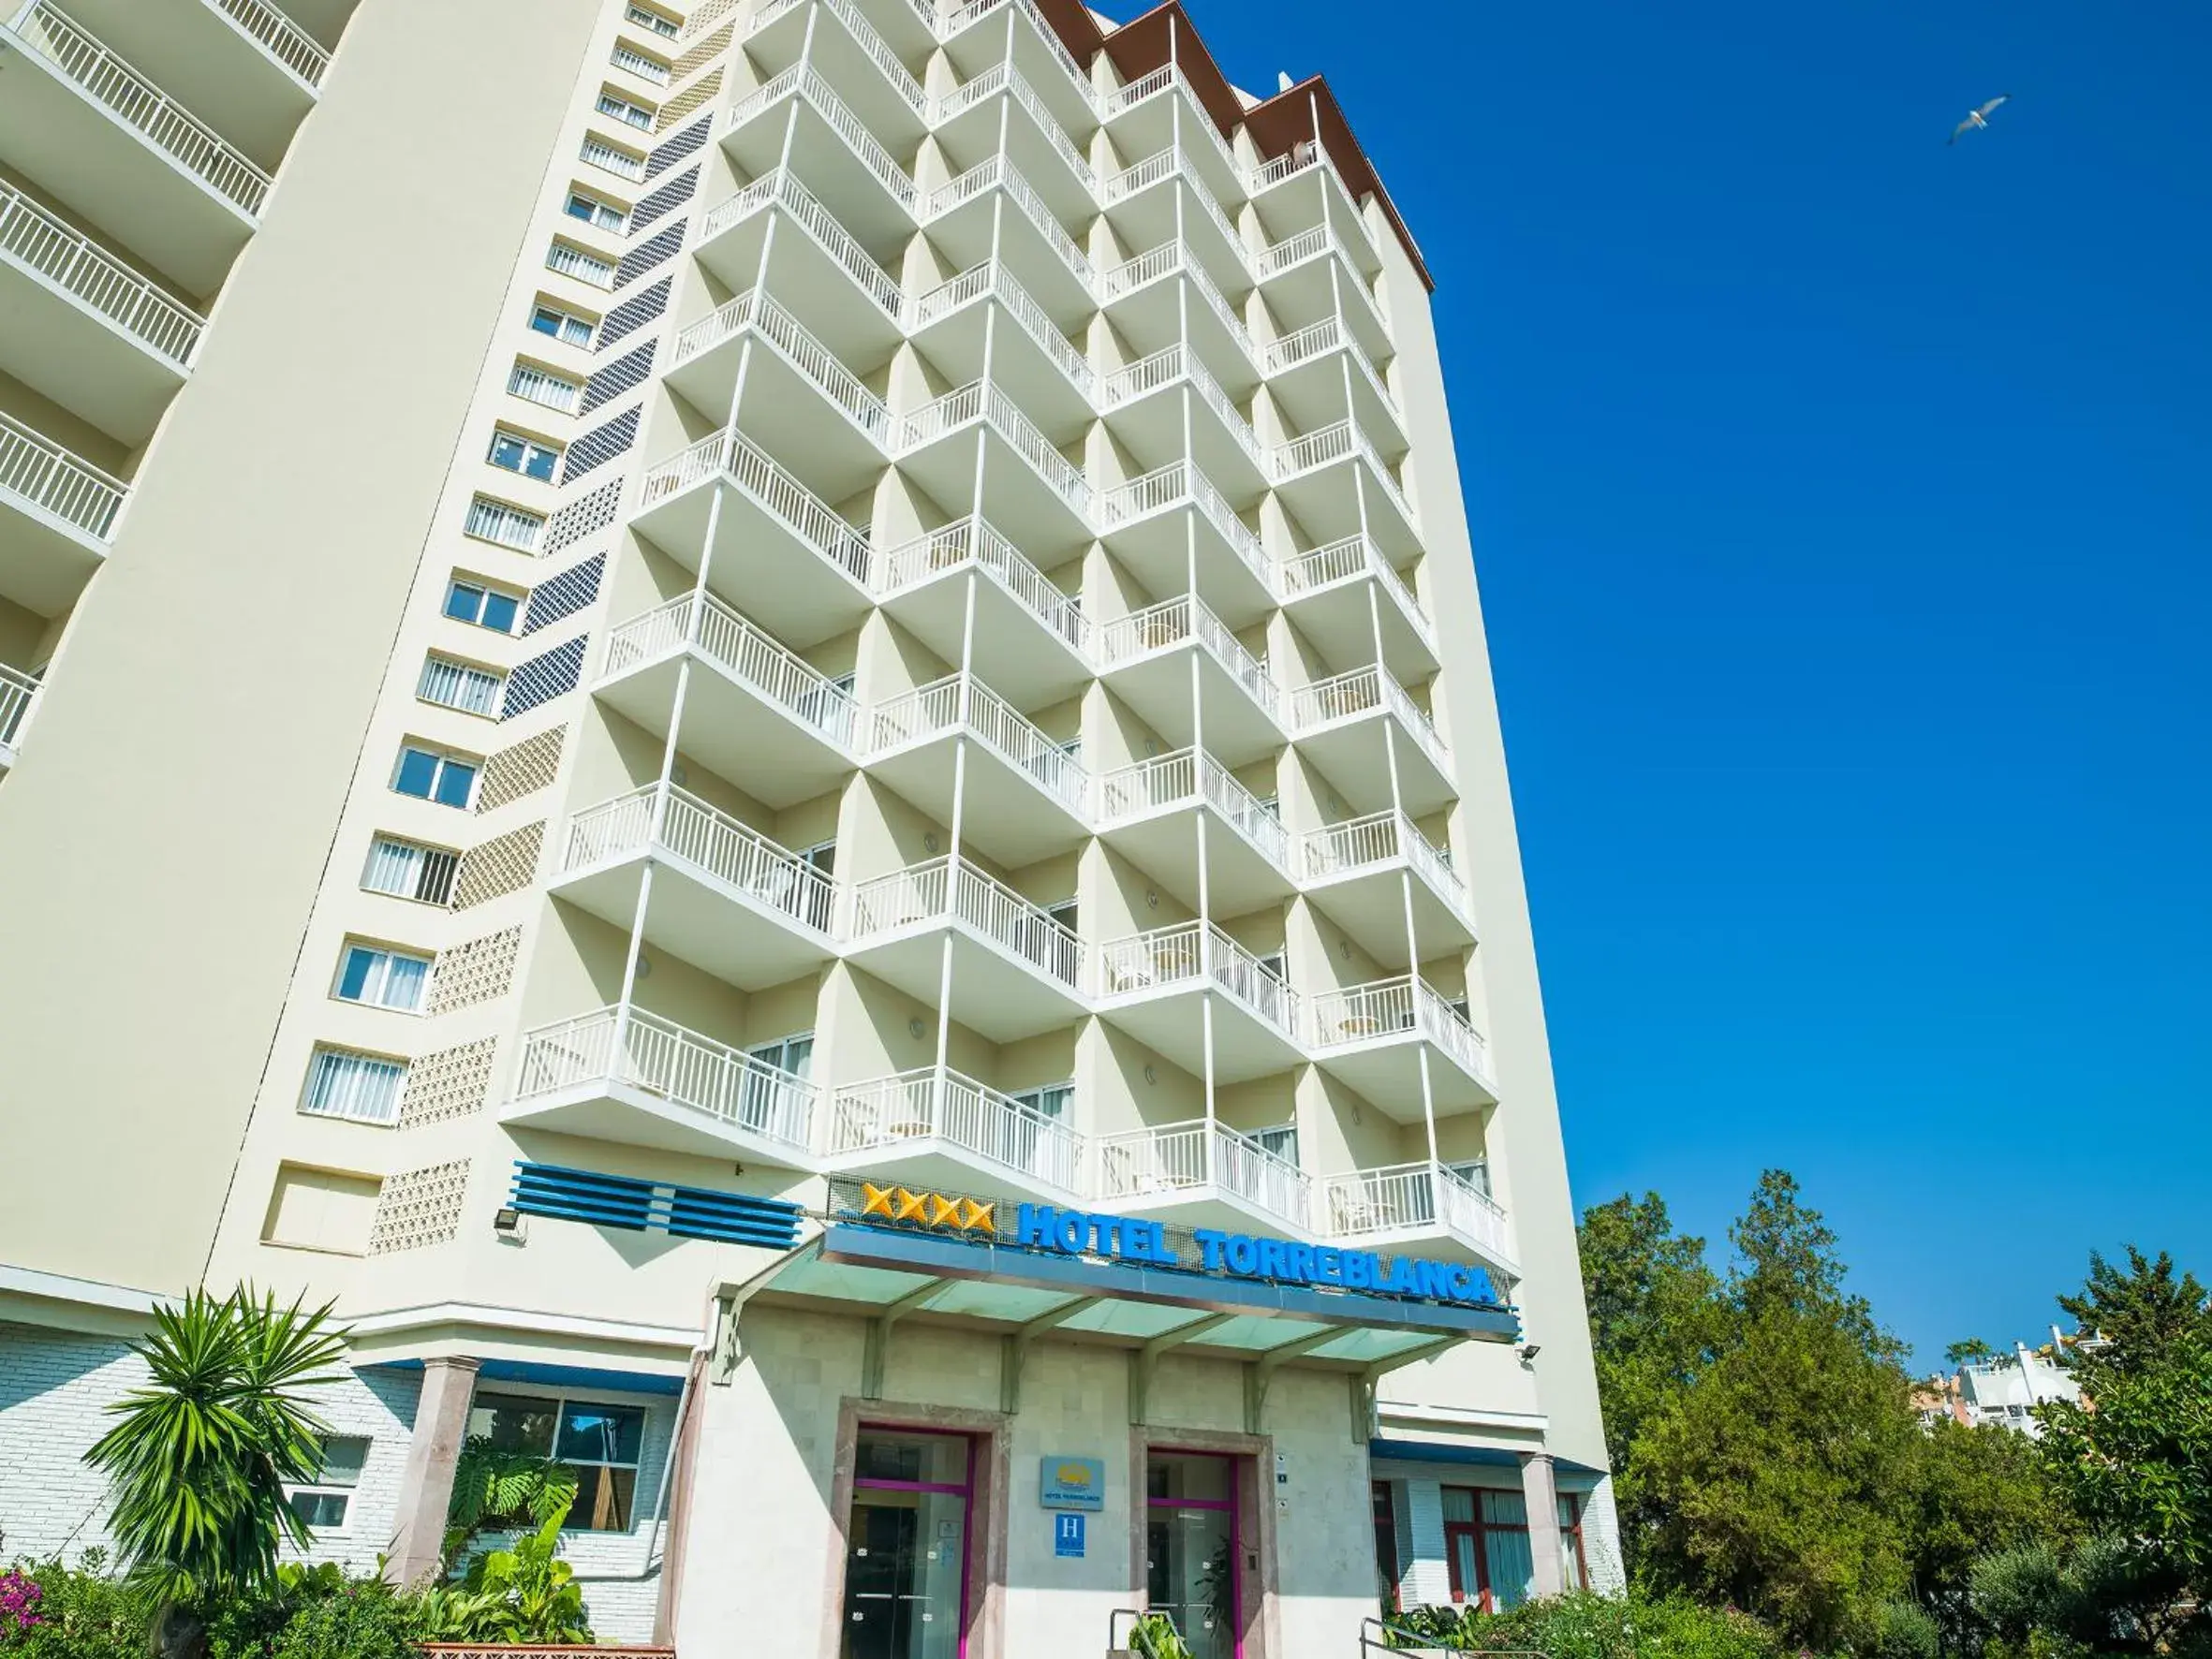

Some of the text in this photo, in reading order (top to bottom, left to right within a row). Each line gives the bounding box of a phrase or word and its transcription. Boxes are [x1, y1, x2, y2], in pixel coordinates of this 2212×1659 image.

[1018, 1202, 1497, 1303] HOTEL TORREBLANCA
[1062, 1518, 1077, 1537] H
